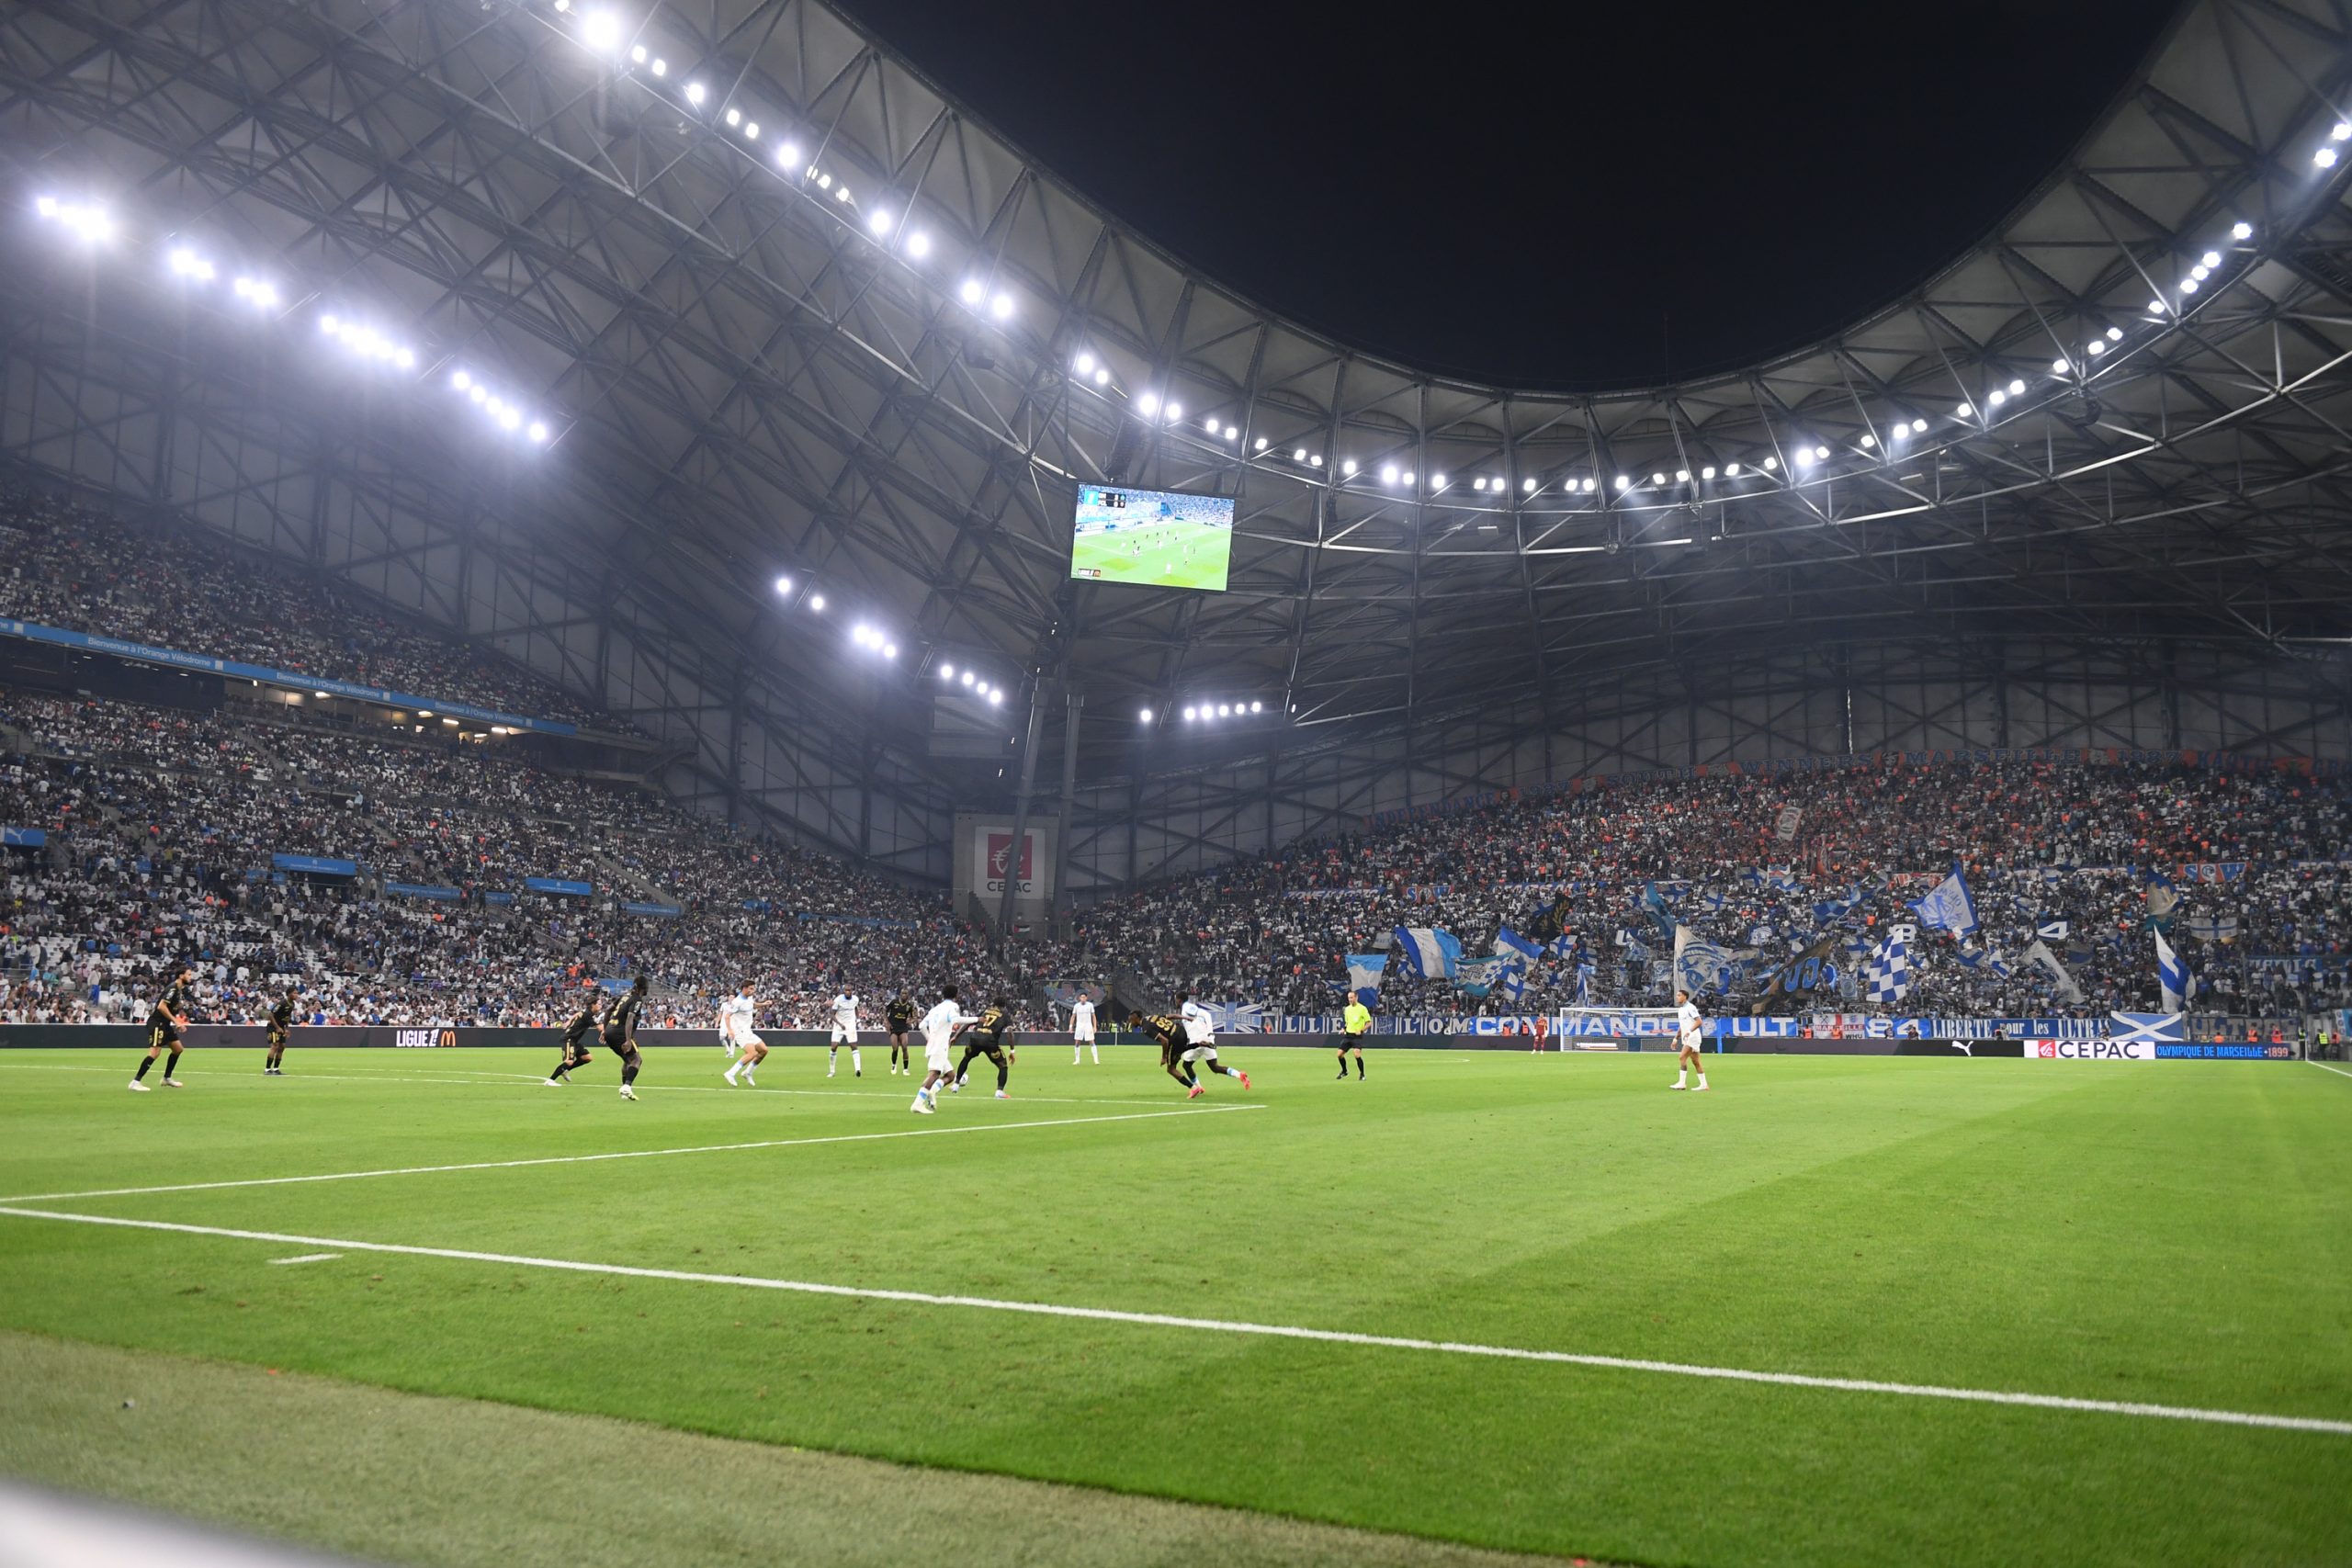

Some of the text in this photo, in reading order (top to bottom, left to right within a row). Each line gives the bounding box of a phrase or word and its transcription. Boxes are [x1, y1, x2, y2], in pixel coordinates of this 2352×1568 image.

[87, 637, 130, 652] Bienvenue
[137, 647, 170, 660] l'Orange
[171, 653, 211, 666] Vélodrome
[277, 671, 311, 684] Bienvenue
[1739, 752, 1873, 774] WINNERS
[1904, 749, 2082, 765] MARSEILLE
[987, 881, 1032, 893] CEAC
[2033, 1020, 2050, 1035] les
[396, 1031, 428, 1047] LIGUE
[2058, 1041, 2141, 1059] CEPAC
[2156, 1045, 2201, 1057] OLYMPIQUE
[2203, 1046, 2214, 1056] DE
[2216, 1046, 2263, 1057] MARSEILLE
